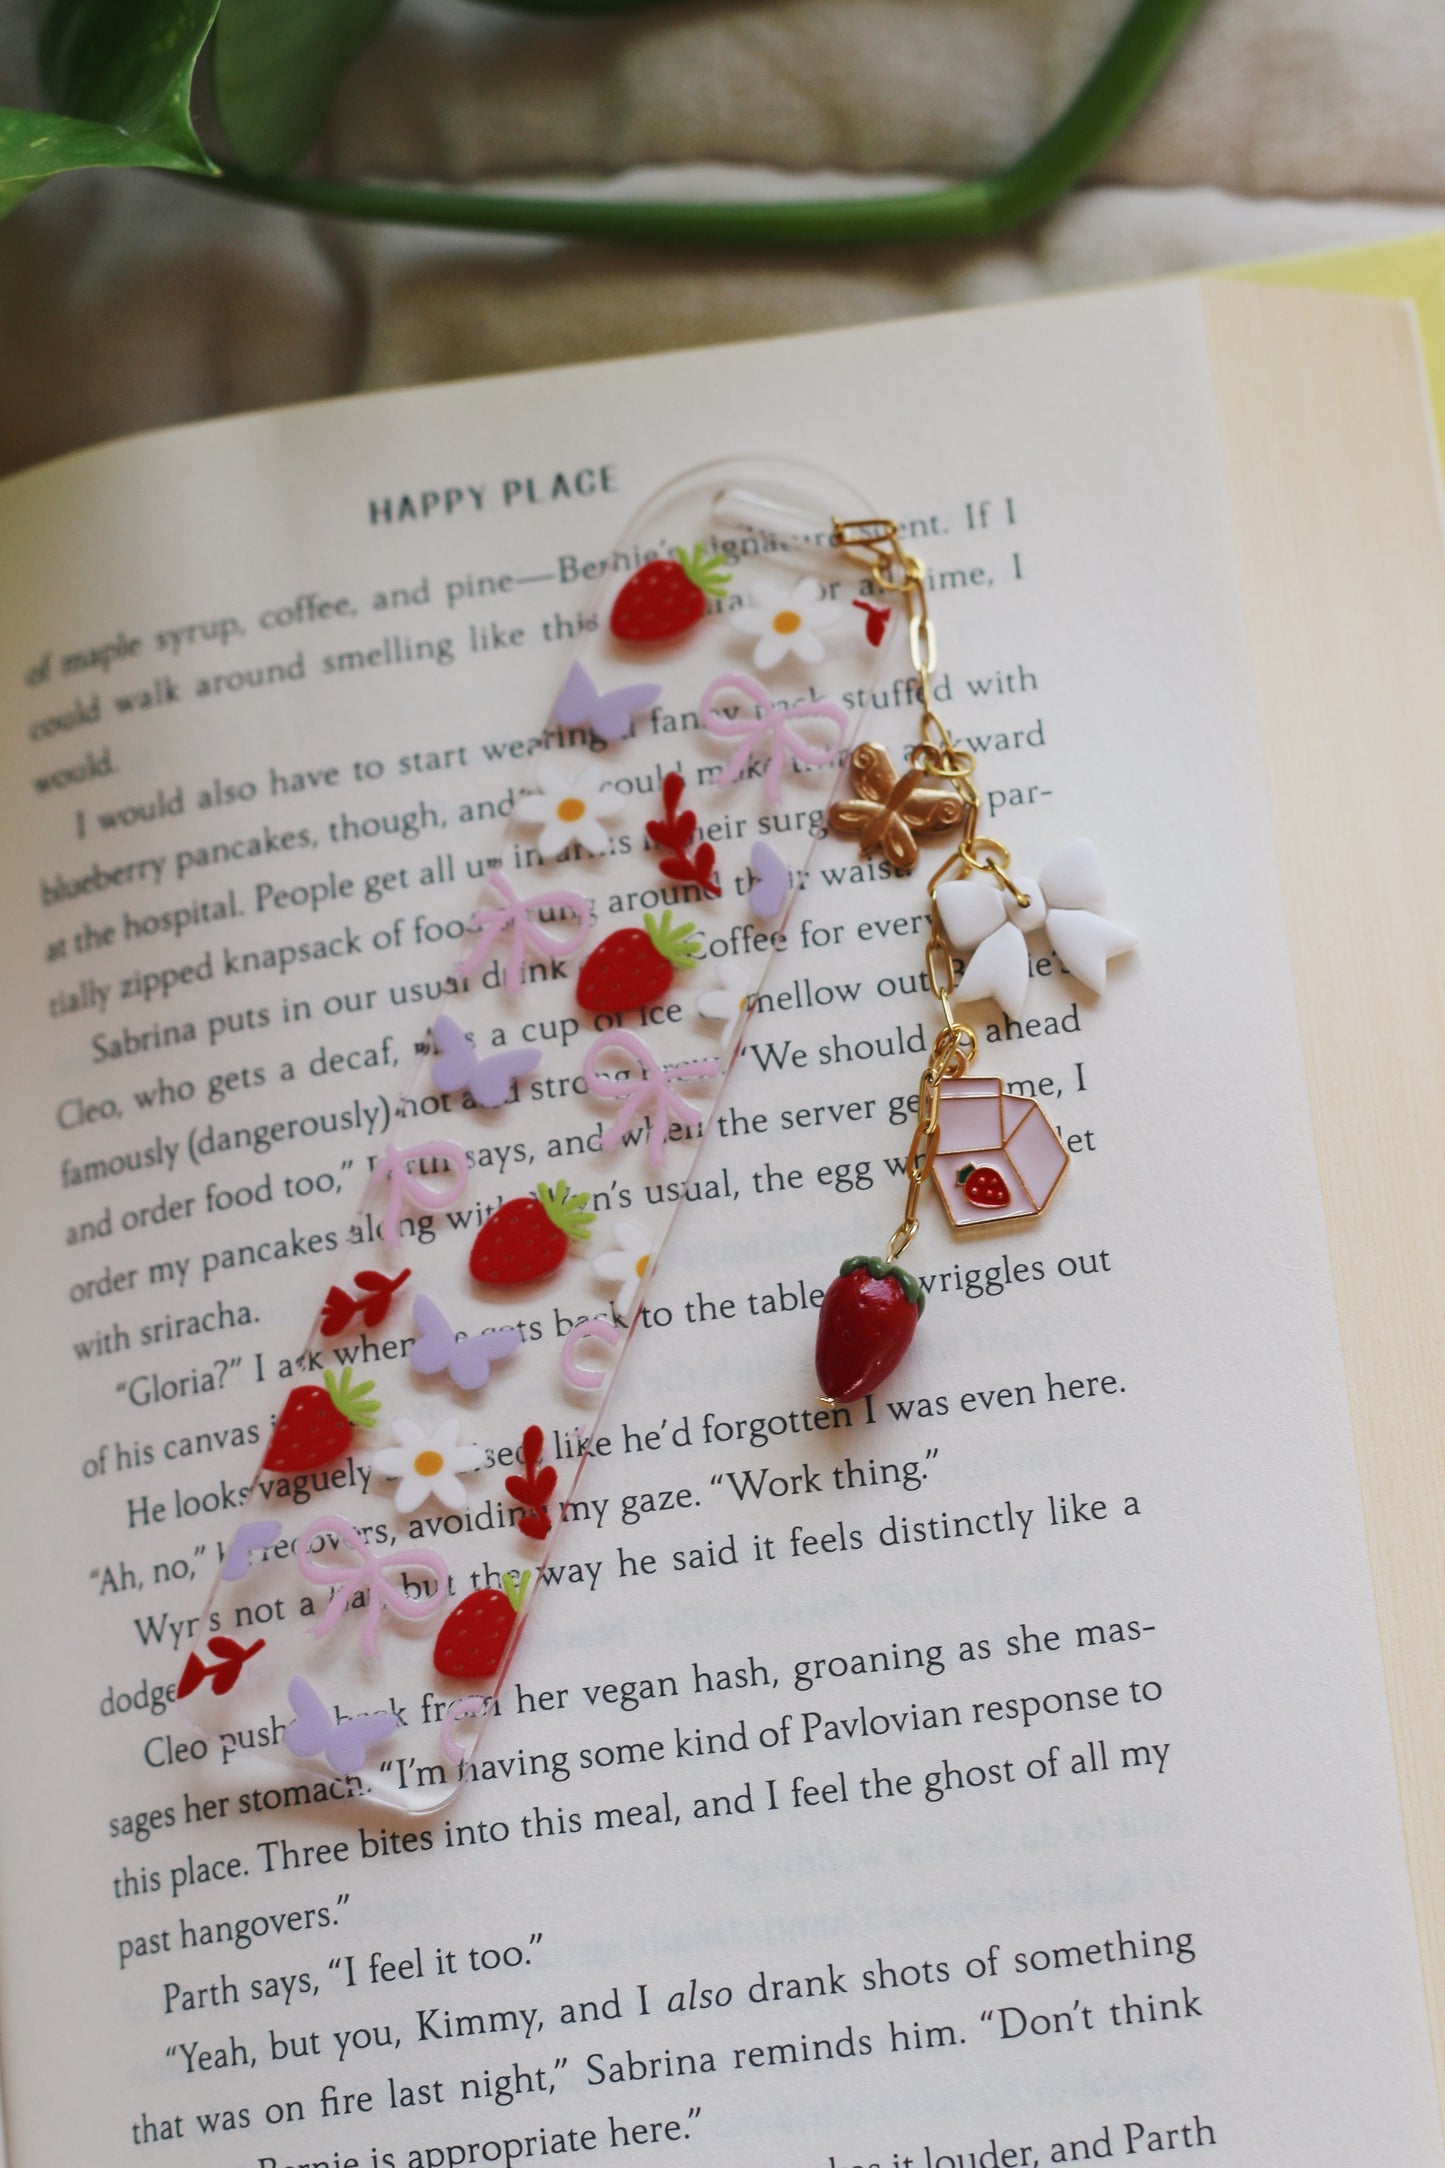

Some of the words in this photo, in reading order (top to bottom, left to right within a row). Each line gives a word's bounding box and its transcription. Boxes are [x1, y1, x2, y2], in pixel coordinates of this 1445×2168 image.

[259, 592, 359, 631] coffee,
[373, 579, 430, 610] and
[966, 501, 990, 530] If
[1003, 496, 1018, 527] I
[369, 487, 483, 525] HAPPY
[503, 463, 618, 506] PLACE
[195, 651, 307, 698] around
[323, 637, 454, 671] smelling
[470, 623, 525, 652] like
[1010, 551, 1025, 582] I
[196, 778, 259, 811] also
[269, 768, 339, 795] have
[353, 761, 385, 782] to
[399, 747, 467, 774] start
[966, 664, 1038, 697] with
[121, 888, 246, 941] hospital.
[255, 871, 354, 913] People
[364, 868, 409, 903] get
[419, 853, 455, 886] all
[987, 785, 1053, 818] par-
[173, 824, 320, 882] pancakes,
[329, 801, 447, 843] though,
[459, 789, 512, 823] and
[90, 1020, 199, 1066] Sabrina
[206, 1006, 273, 1048] puts
[282, 998, 312, 1023] in
[323, 990, 377, 1016] our
[800, 919, 845, 949] for
[221, 924, 364, 978] knapsack
[372, 918, 405, 950] of
[59, 1134, 182, 1191] famously
[188, 1095, 391, 1164] (dangerously)
[818, 1022, 928, 1066] should
[986, 1003, 1081, 1042] ahead
[132, 1075, 198, 1111] who
[205, 1065, 268, 1107] gets
[279, 1062, 296, 1082] a
[309, 1035, 399, 1077] decaf,
[491, 1027, 507, 1047] a
[521, 1017, 581, 1048] cup
[640, 1004, 683, 1027] ice
[64, 1205, 115, 1248] and
[119, 1191, 198, 1233] order
[203, 1170, 276, 1215] food
[283, 1159, 354, 1199] too,”
[547, 1122, 607, 1158] and
[716, 1106, 768, 1138] the
[780, 1099, 877, 1131] server
[1073, 1061, 1088, 1092] I
[68, 1264, 140, 1306] order
[146, 1256, 192, 1290] my
[202, 1228, 338, 1282] pancakes
[644, 1167, 740, 1205] usual,
[751, 1162, 804, 1194] the
[816, 1161, 874, 1194] egg
[115, 1356, 242, 1407] “Gloria?”
[254, 1352, 265, 1383] I
[641, 1304, 673, 1329] to
[684, 1291, 736, 1324] the
[1057, 1249, 1112, 1277] out
[138, 1298, 262, 1348] sriracha.
[126, 1495, 166, 1529] He
[260, 1457, 372, 1505] vaguely
[621, 1415, 693, 1454] he’d
[702, 1408, 853, 1448] forgotten
[865, 1394, 877, 1425] I
[886, 1395, 950, 1422] was
[960, 1385, 1037, 1413] even
[1044, 1371, 1126, 1403] here.
[163, 1424, 260, 1460] canvas
[153, 1544, 206, 1584] no,”
[621, 1488, 701, 1526] gaze.
[710, 1463, 824, 1502] “Work
[832, 1447, 939, 1492] thing.”
[234, 1598, 286, 1628] not
[299, 1596, 317, 1617] a
[534, 1559, 603, 1592] way
[615, 1546, 657, 1578] he
[672, 1533, 739, 1571] said
[753, 1534, 776, 1562] it
[789, 1520, 864, 1558] feels
[879, 1500, 1035, 1547] distinctly
[1047, 1492, 1108, 1526] like
[1123, 1496, 1142, 1516] a
[109, 1806, 176, 1843] sages
[183, 1792, 230, 1824] her
[380, 1756, 447, 1789] “I’m
[579, 1740, 665, 1770] some
[673, 1719, 751, 1759] kind
[758, 1714, 793, 1749] of
[800, 1703, 963, 1744] Pavlovian
[971, 1686, 1120, 1728] response
[1128, 1680, 1163, 1704] to
[143, 1734, 208, 1768] Cleo
[514, 1683, 569, 1714] her
[581, 1676, 679, 1713] vegan
[690, 1655, 779, 1694] hash,
[793, 1642, 946, 1692] groaning
[958, 1639, 992, 1662] as
[1006, 1623, 1061, 1657] she
[1074, 1620, 1156, 1648] mas-
[113, 1866, 162, 1899] this
[170, 1854, 249, 1899] place.
[256, 1839, 350, 1873] Three
[358, 1827, 434, 1859] bites
[444, 1820, 510, 1848] into
[520, 1806, 583, 1839] this
[593, 1791, 681, 1831] meal,
[693, 1781, 756, 1819] and
[764, 1779, 780, 1811] I
[790, 1771, 849, 1808] feel
[858, 1767, 913, 1800] the
[924, 1758, 1016, 1803] ghost
[1026, 1745, 1061, 1780] of
[1070, 1739, 1110, 1775] all
[1119, 1743, 1171, 1775] my
[117, 1929, 172, 1971] past
[178, 1892, 350, 1950] hangovers.”
[163, 1973, 240, 2015] Parth
[250, 1972, 319, 2006] says,
[328, 1955, 358, 1987] “I
[368, 1946, 425, 1984] feel
[435, 1947, 458, 1976] it
[467, 1932, 543, 1972] too.”
[165, 2035, 257, 2074] “Yeah,
[268, 2029, 322, 2061] but
[332, 2025, 401, 2062] you,
[415, 2008, 544, 2042] Kimmy,
[559, 1987, 623, 2025] and
[636, 1983, 651, 2016] I
[667, 1978, 733, 2013] also
[748, 1963, 849, 2004] drank
[862, 1957, 951, 1991] shots
[965, 1944, 1001, 1979] of
[1014, 1929, 1196, 1974] something
[131, 2112, 185, 2146] that
[195, 2107, 251, 2135] was
[265, 2100, 306, 2125] on
[319, 2084, 373, 2118] fire
[387, 2077, 445, 2109] last
[460, 2057, 568, 2107] night,”
[586, 2049, 717, 2086] Sabrina
[732, 2025, 873, 2070] reminds
[887, 2020, 966, 2053] him.
[980, 1999, 1095, 2040] “Don’t
[1109, 1985, 1204, 2027] think
[607, 2106, 702, 2148] here.”
[1050, 2125, 1114, 2164] and
[1122, 2114, 1217, 2155] Parth
